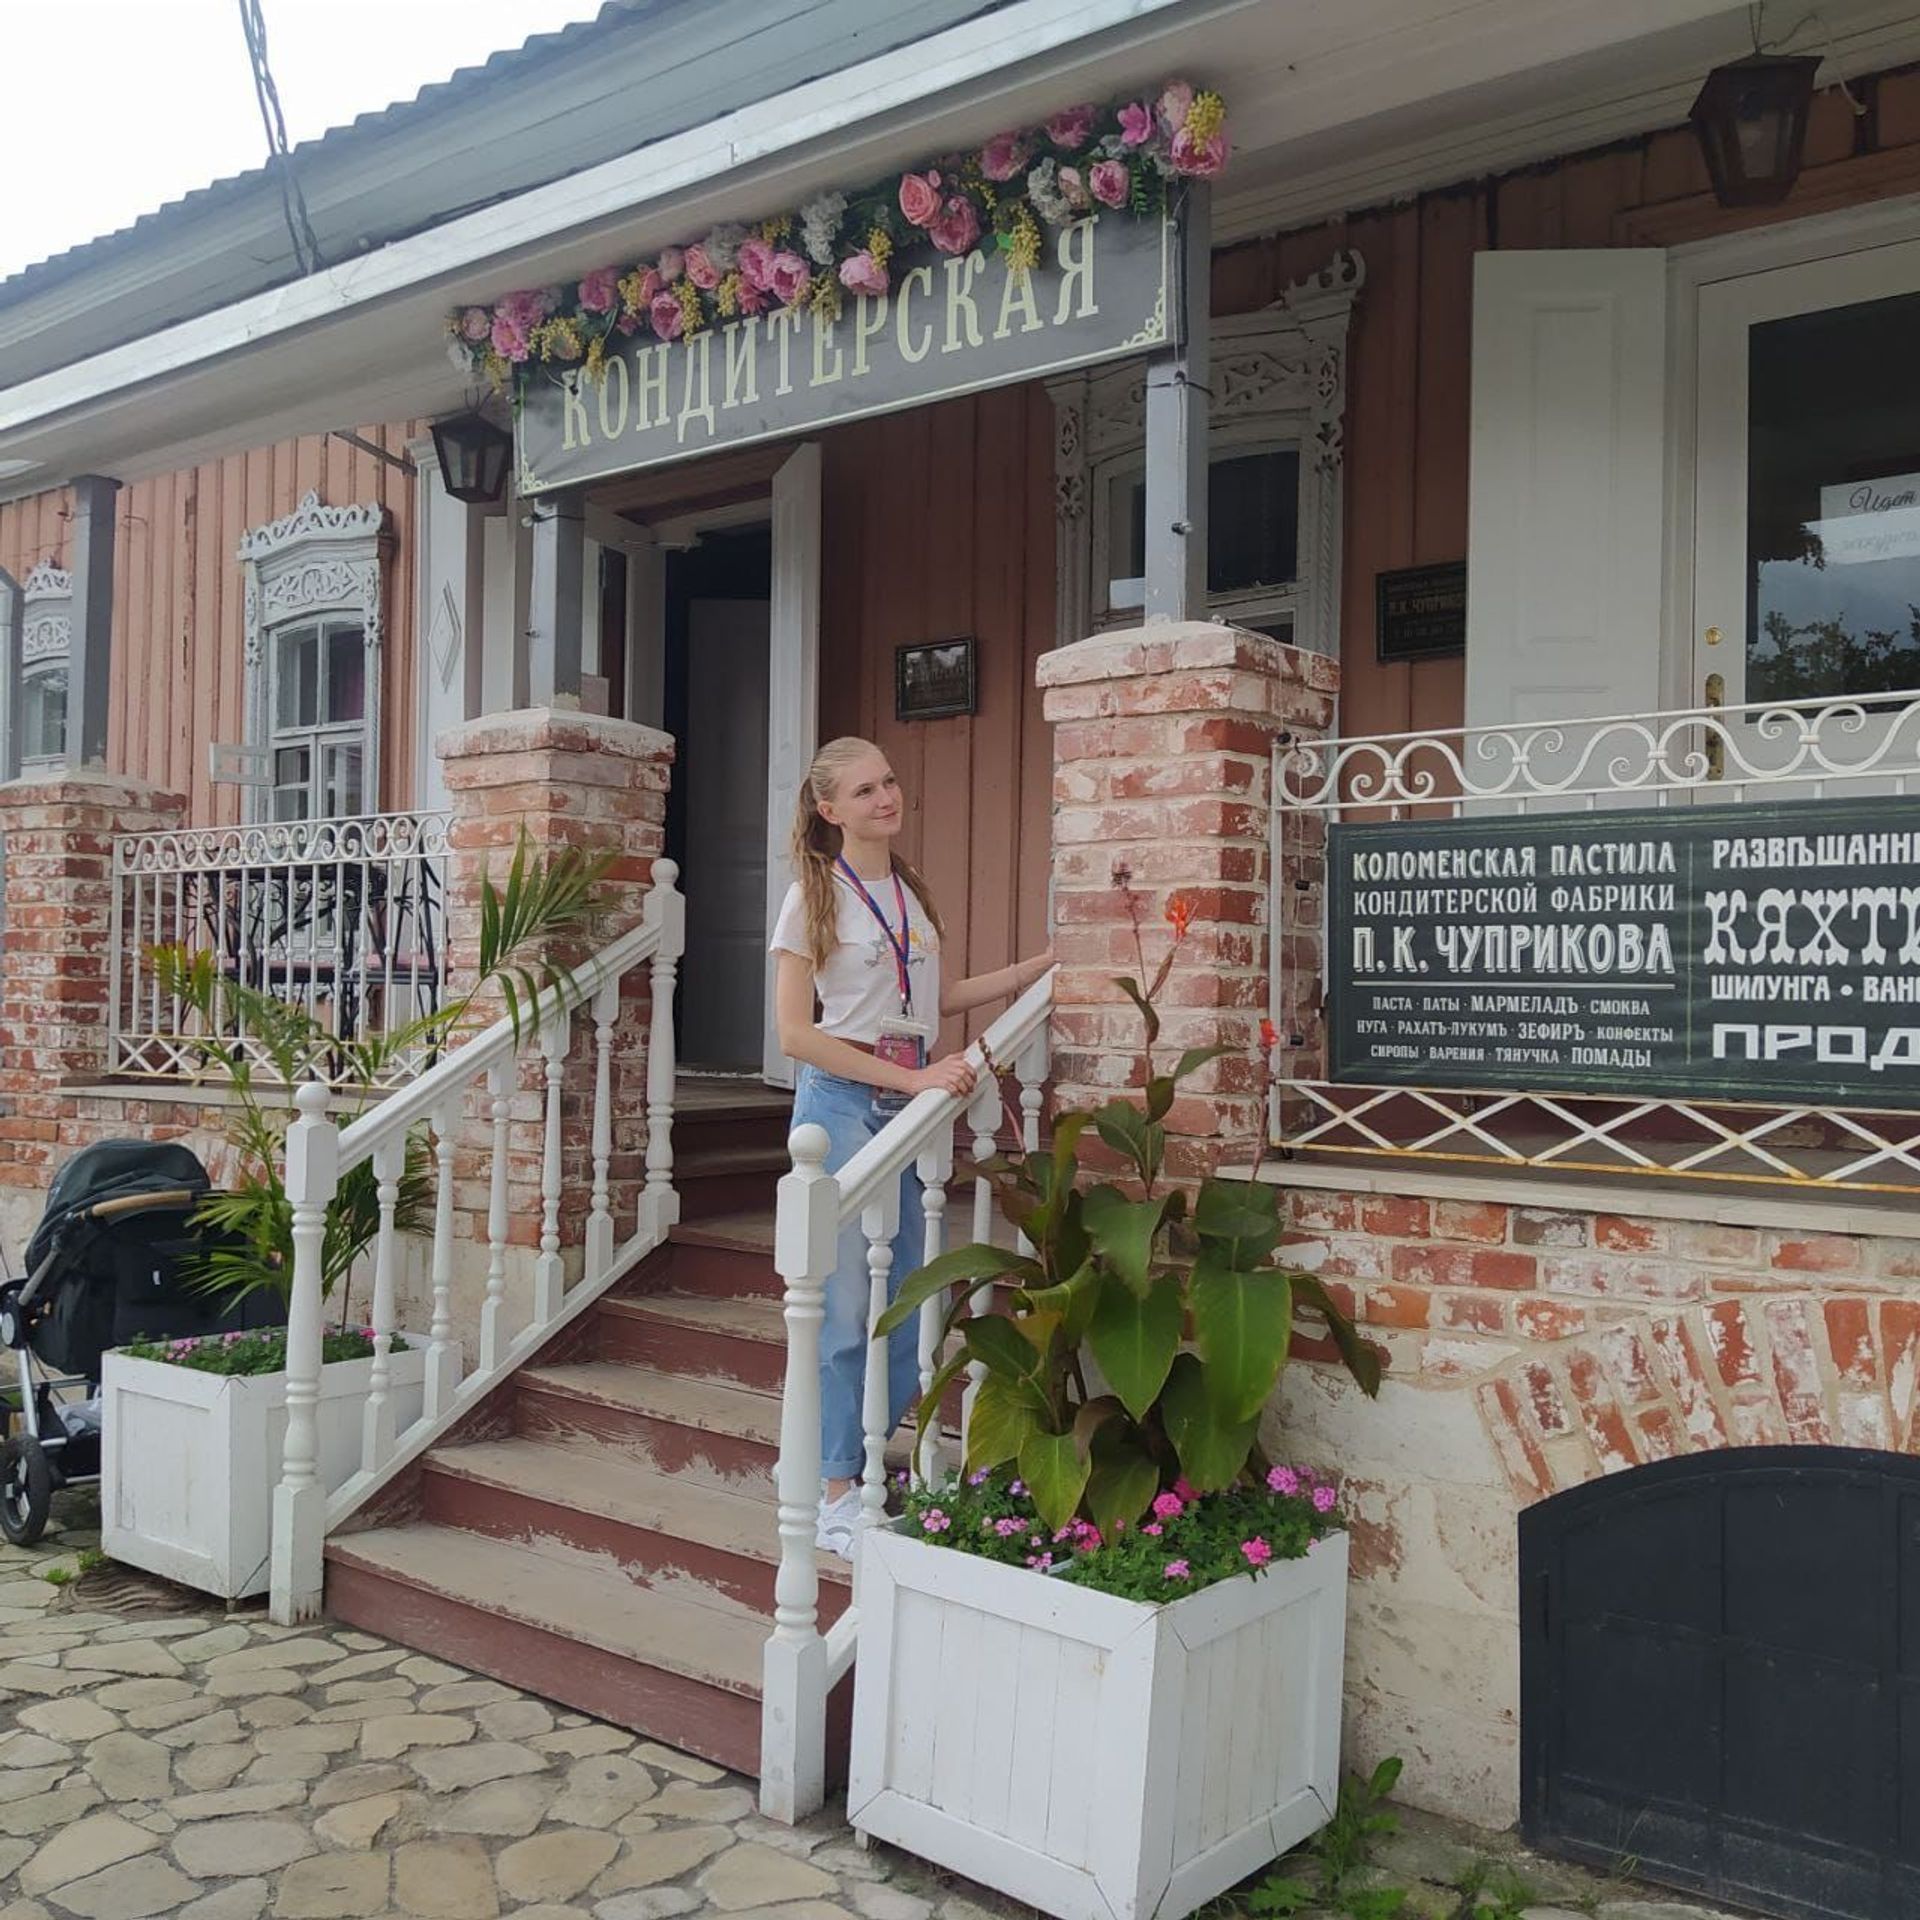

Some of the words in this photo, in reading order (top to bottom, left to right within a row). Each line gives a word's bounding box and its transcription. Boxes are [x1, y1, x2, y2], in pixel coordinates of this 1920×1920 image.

[561, 214, 1100, 450] КОНДИТЕРСКАЯ
[1352, 847, 1536, 882] КОЛОМЕНСКАЯ
[1550, 841, 1676, 876] ПАСТИЛА
[1353, 882, 1538, 918] КОНДИТЕРСКОЙ
[1551, 884, 1676, 912] ФАБРИКИ
[1352, 926, 1387, 973] П.
[1392, 926, 1430, 973] К.
[1434, 923, 1676, 974] ЧУПРИКОВА
[1711, 975, 1831, 1001] ШИЛУНГА
[1372, 996, 1413, 1011] ПАСТА
[1422, 997, 1460, 1011] ПАТЫ
[1470, 995, 1579, 1016] МАРМЕЛАДЪ
[1590, 999, 1650, 1016] СМОКВА
[1357, 1020, 1388, 1034] НУГА
[1518, 1022, 1585, 1041] ЗЕФИРЪ
[1597, 1025, 1674, 1042] КОНФЕКТЫ
[1370, 1045, 1419, 1059] СИРОПЫ
[1429, 1046, 1485, 1062] ВАРЕНИЯ
[1495, 1047, 1560, 1064] ТЯНУЧКА
[1571, 1047, 1652, 1070] ПОМАДЫ
